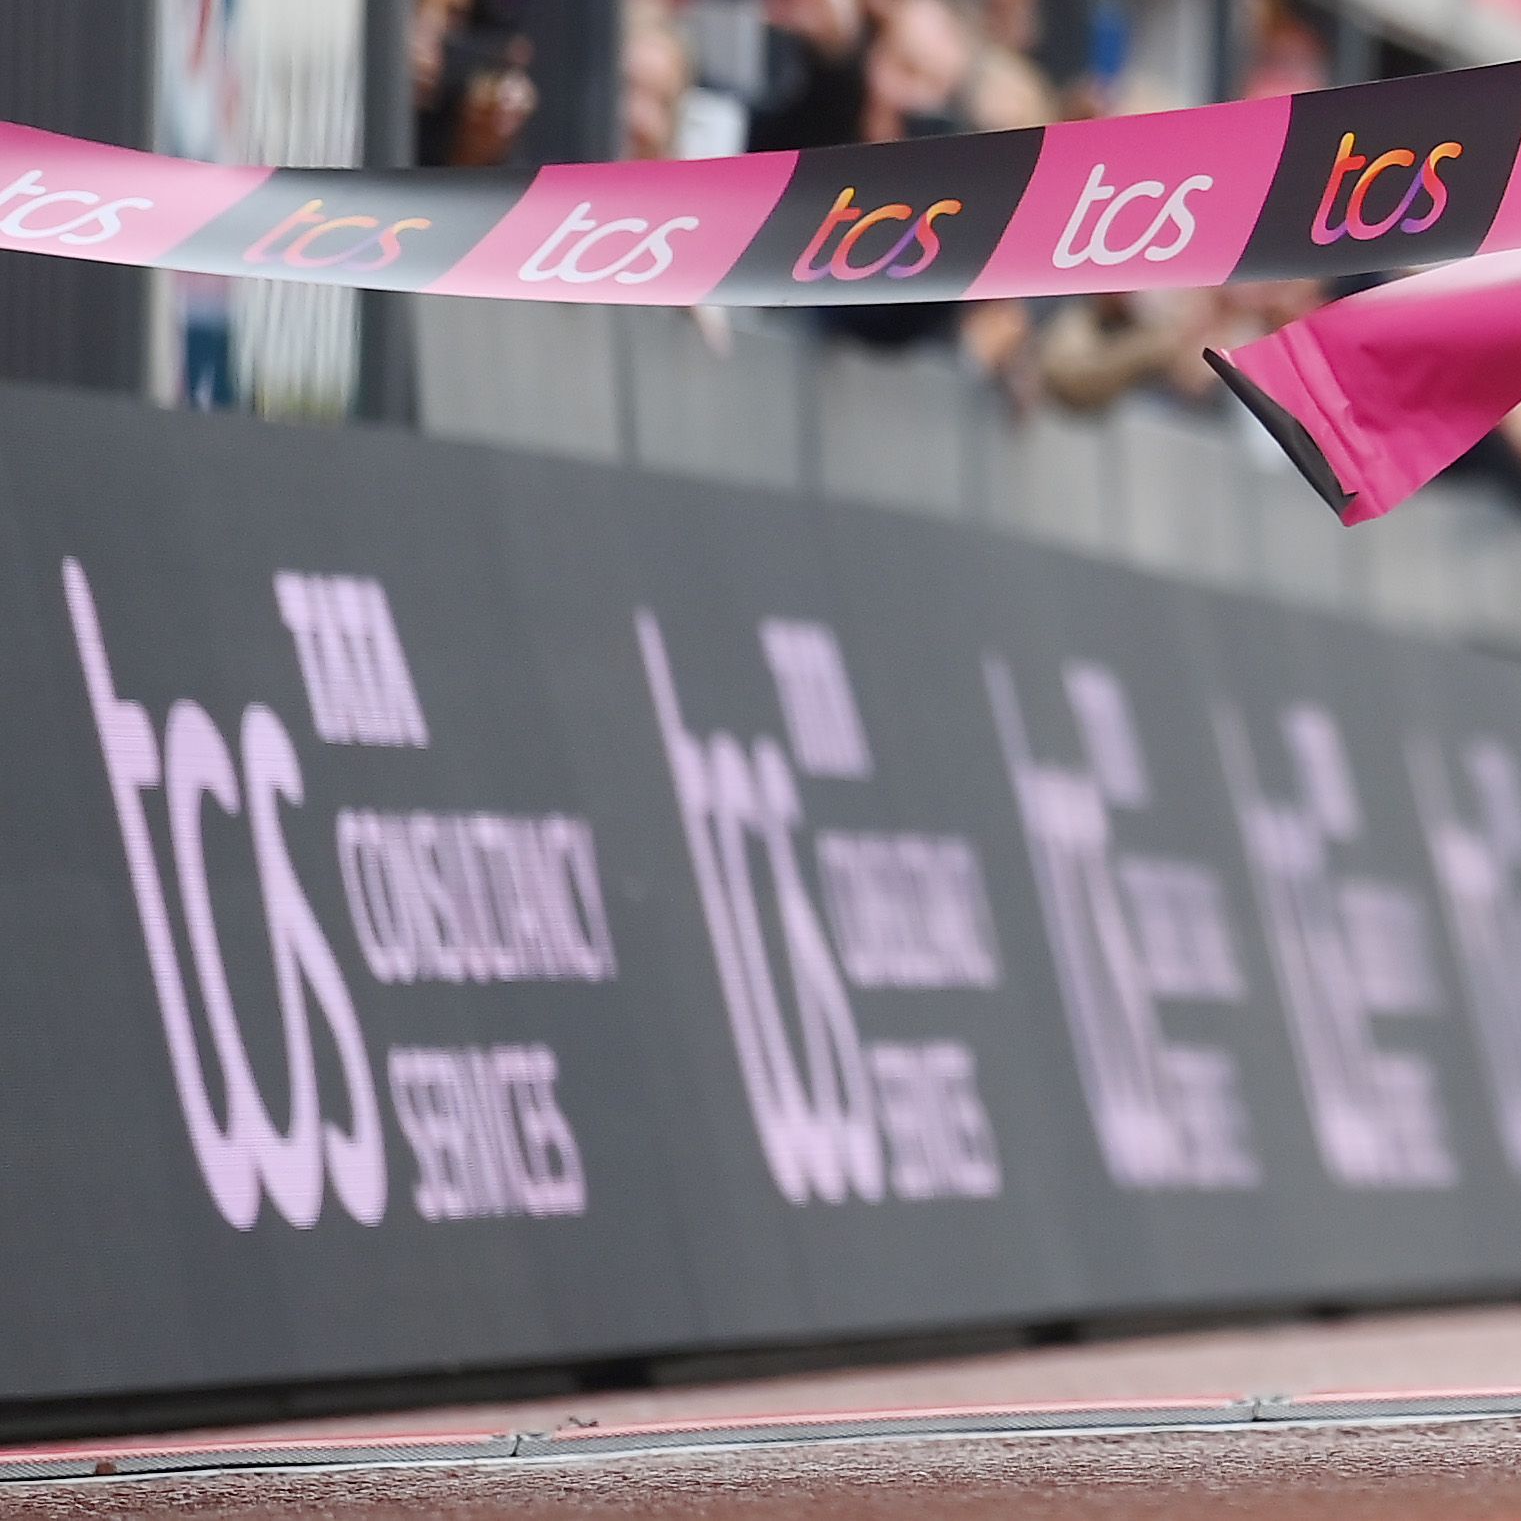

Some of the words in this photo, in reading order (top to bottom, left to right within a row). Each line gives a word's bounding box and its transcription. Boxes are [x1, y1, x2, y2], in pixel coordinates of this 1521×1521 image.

[243, 199, 431, 271] tcs
[792, 187, 962, 281] tcs
[1052, 164, 1213, 269] tcs
[1311, 132, 1463, 247] tcs
[518, 202, 699, 285] tcs
[62, 555, 388, 1230] tcs
